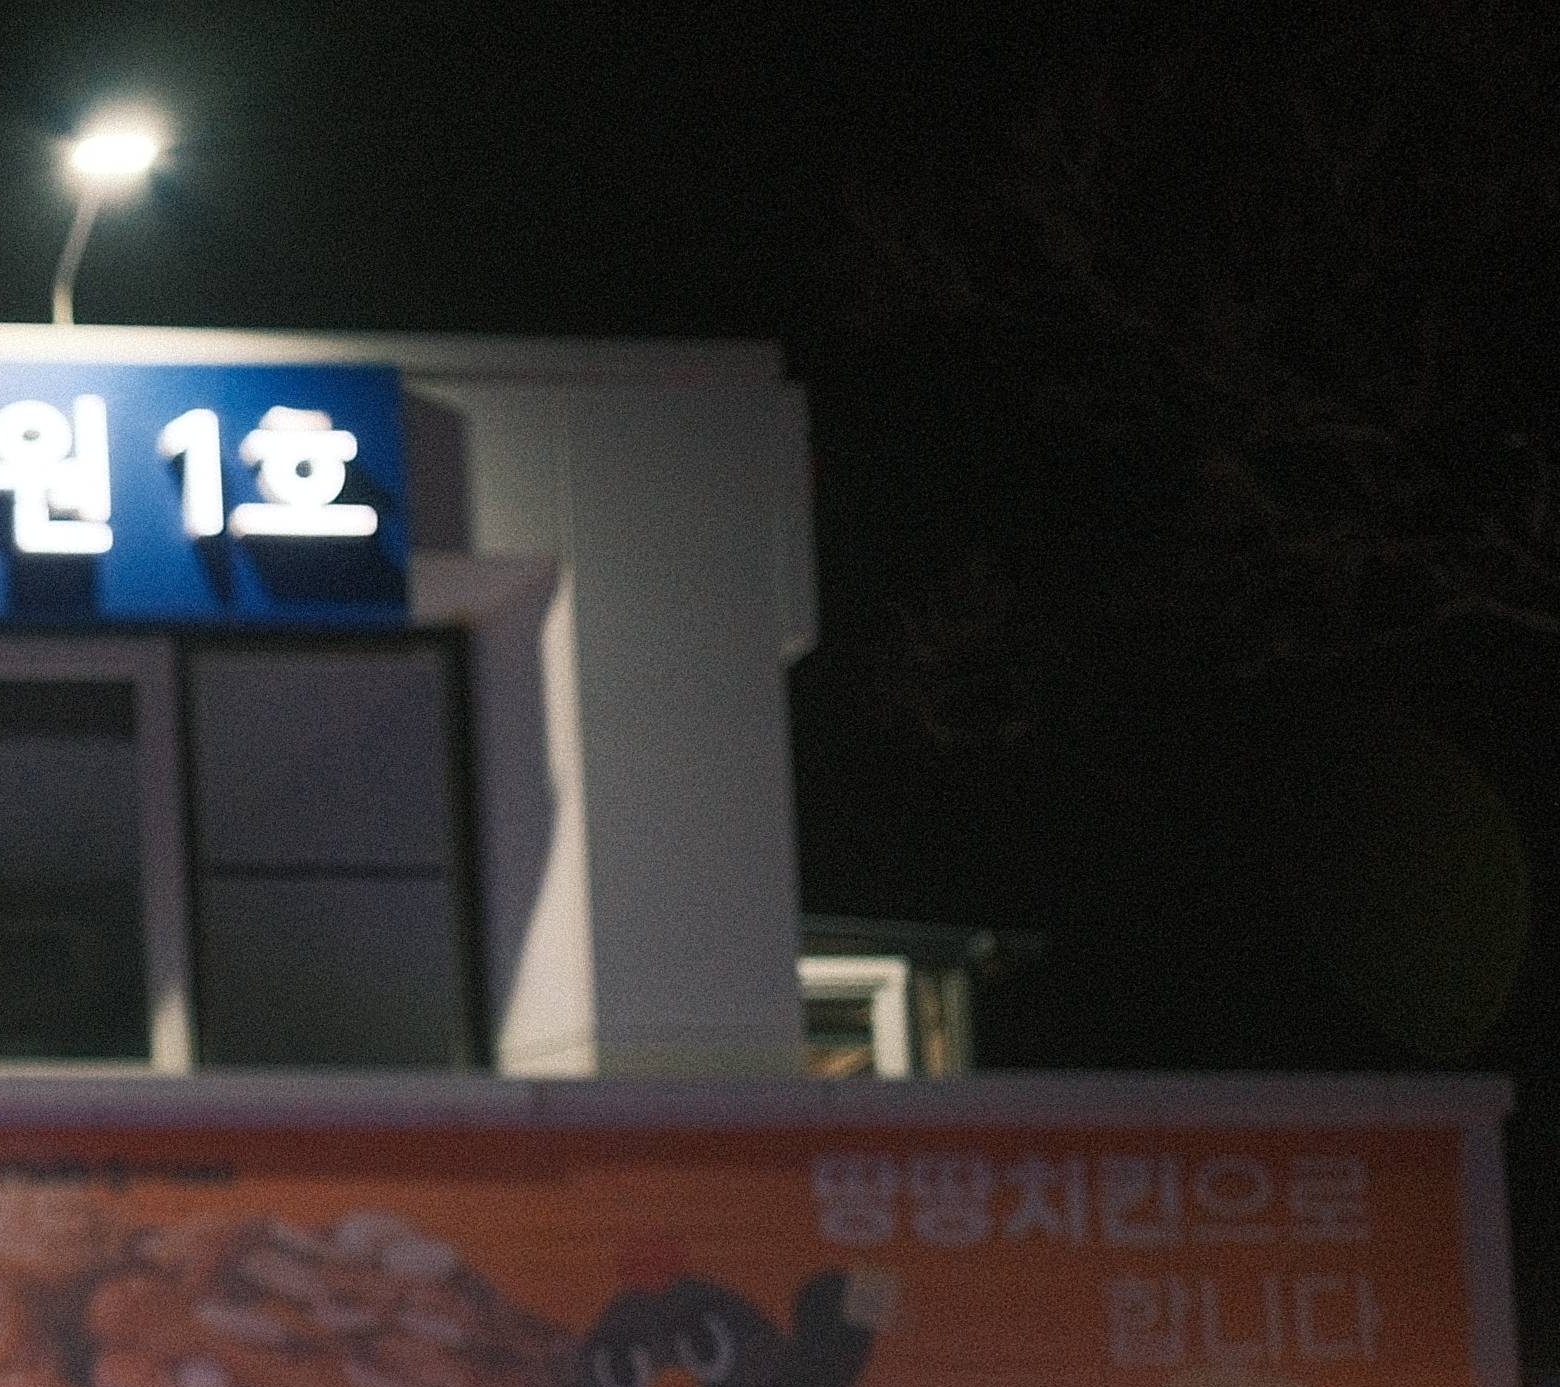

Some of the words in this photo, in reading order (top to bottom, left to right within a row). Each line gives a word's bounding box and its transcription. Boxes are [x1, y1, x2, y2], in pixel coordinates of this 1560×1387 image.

[157, 404, 380, 541] 1호
[810, 1152, 1374, 1248] 땅땅치킨으로
[1102, 1271, 1383, 1366] 합니다
